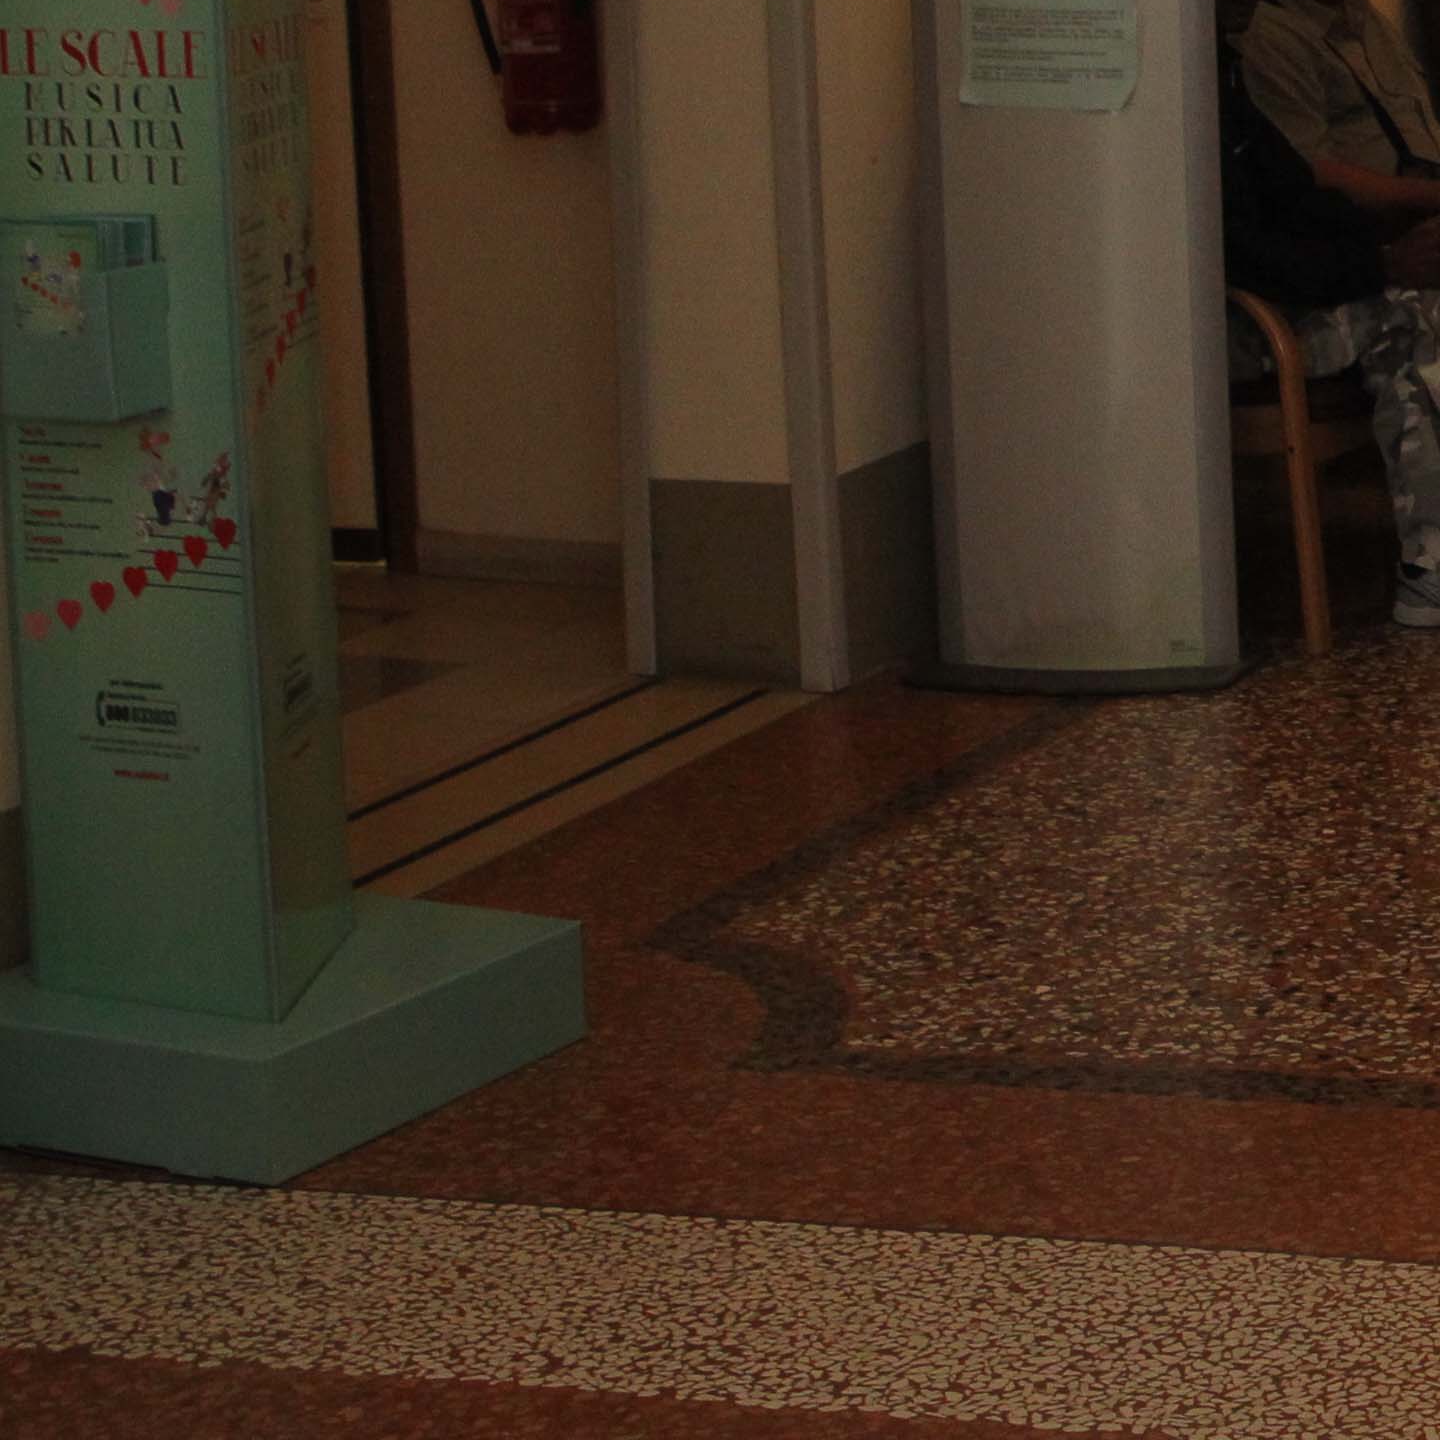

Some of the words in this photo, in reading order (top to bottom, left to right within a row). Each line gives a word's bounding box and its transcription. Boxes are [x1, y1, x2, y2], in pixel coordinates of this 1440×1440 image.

[0, 28, 48, 76] LE
[60, 28, 208, 80] SCALE
[23, 80, 184, 114] MUSICA
[26, 151, 189, 186] SALUTE
